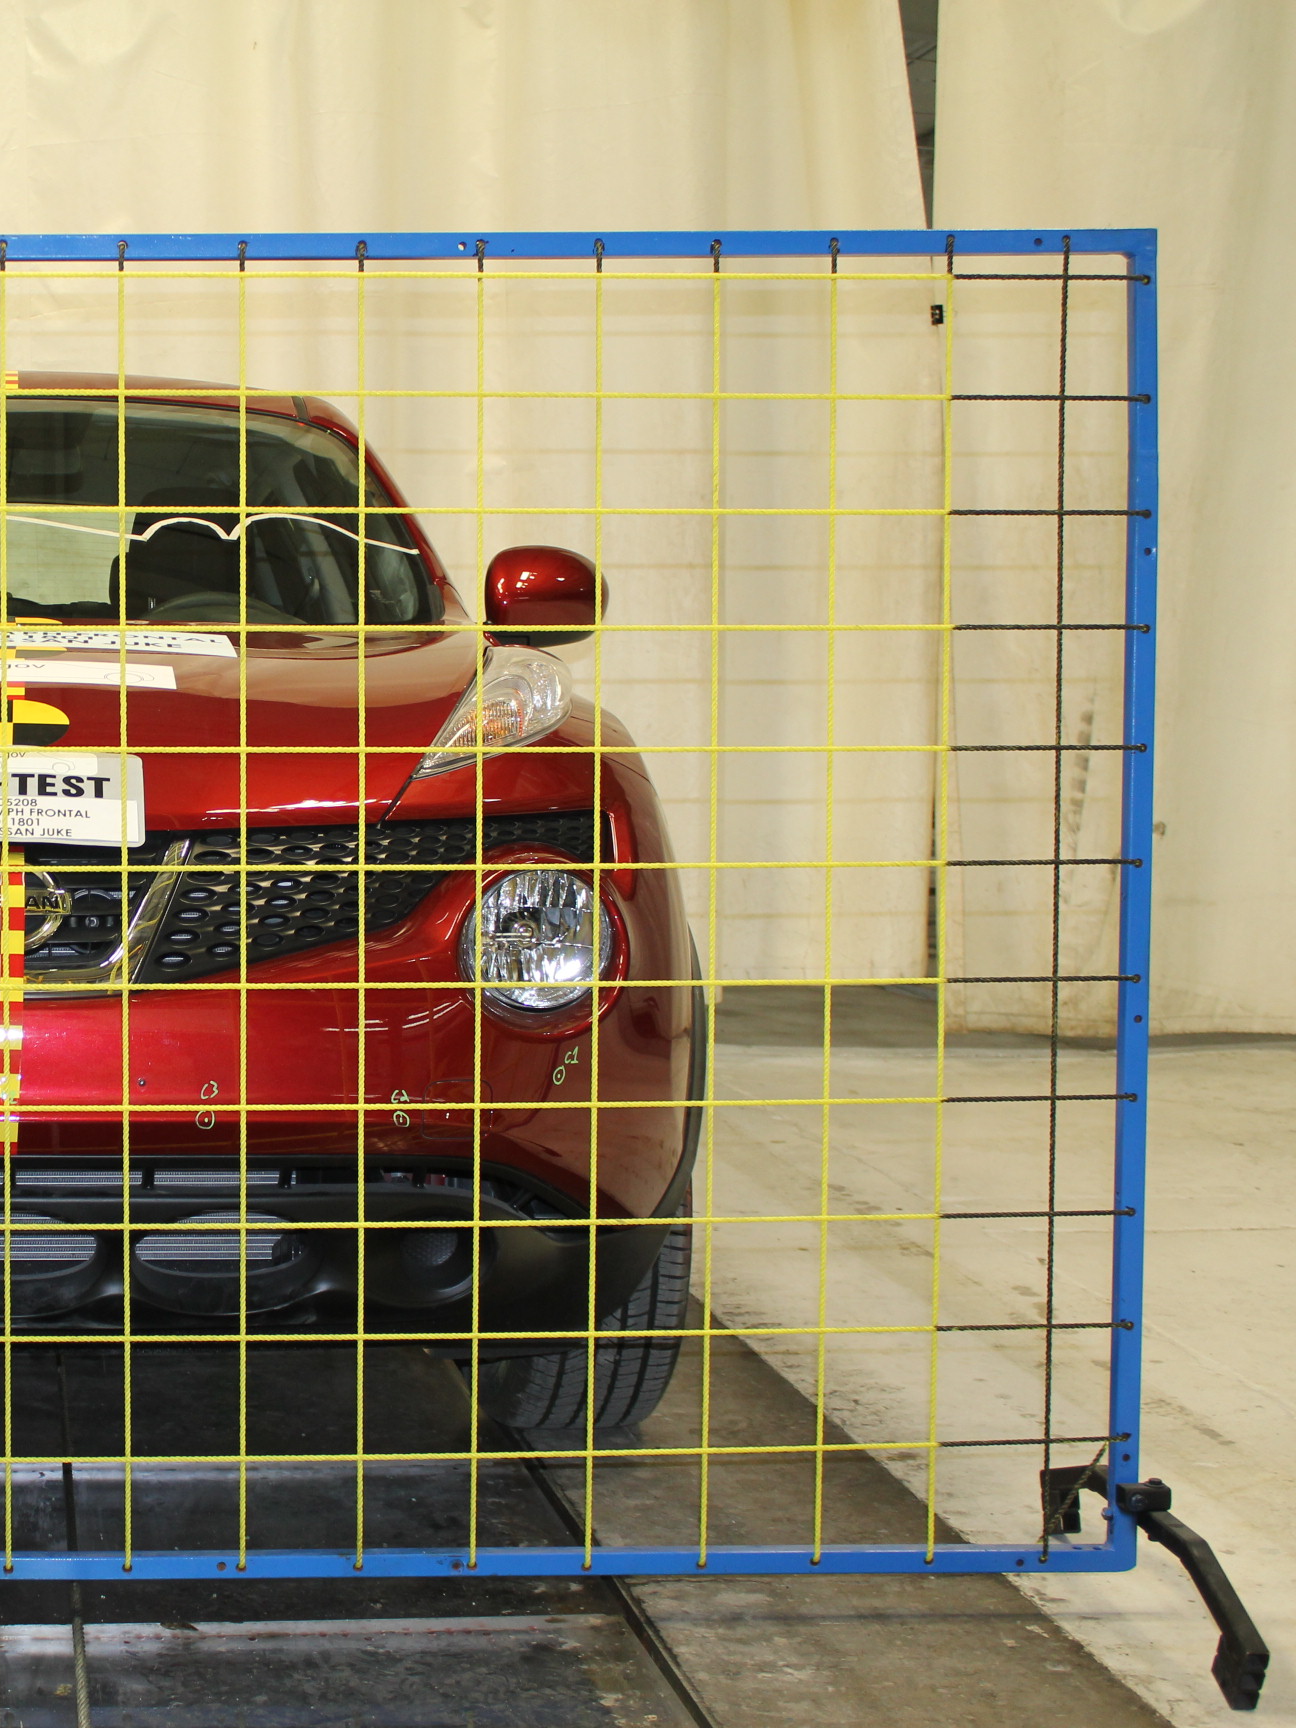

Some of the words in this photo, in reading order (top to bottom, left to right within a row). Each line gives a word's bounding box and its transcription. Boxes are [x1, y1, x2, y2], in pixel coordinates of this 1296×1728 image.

[76, 632, 223, 644] FRONTAL
[103, 640, 183, 649] JUKE
[29, 808, 91, 819] FRONTAL
[39, 828, 73, 838] JUKE
[564, 1046, 579, 1064] C1
[200, 1080, 219, 1100] C3
